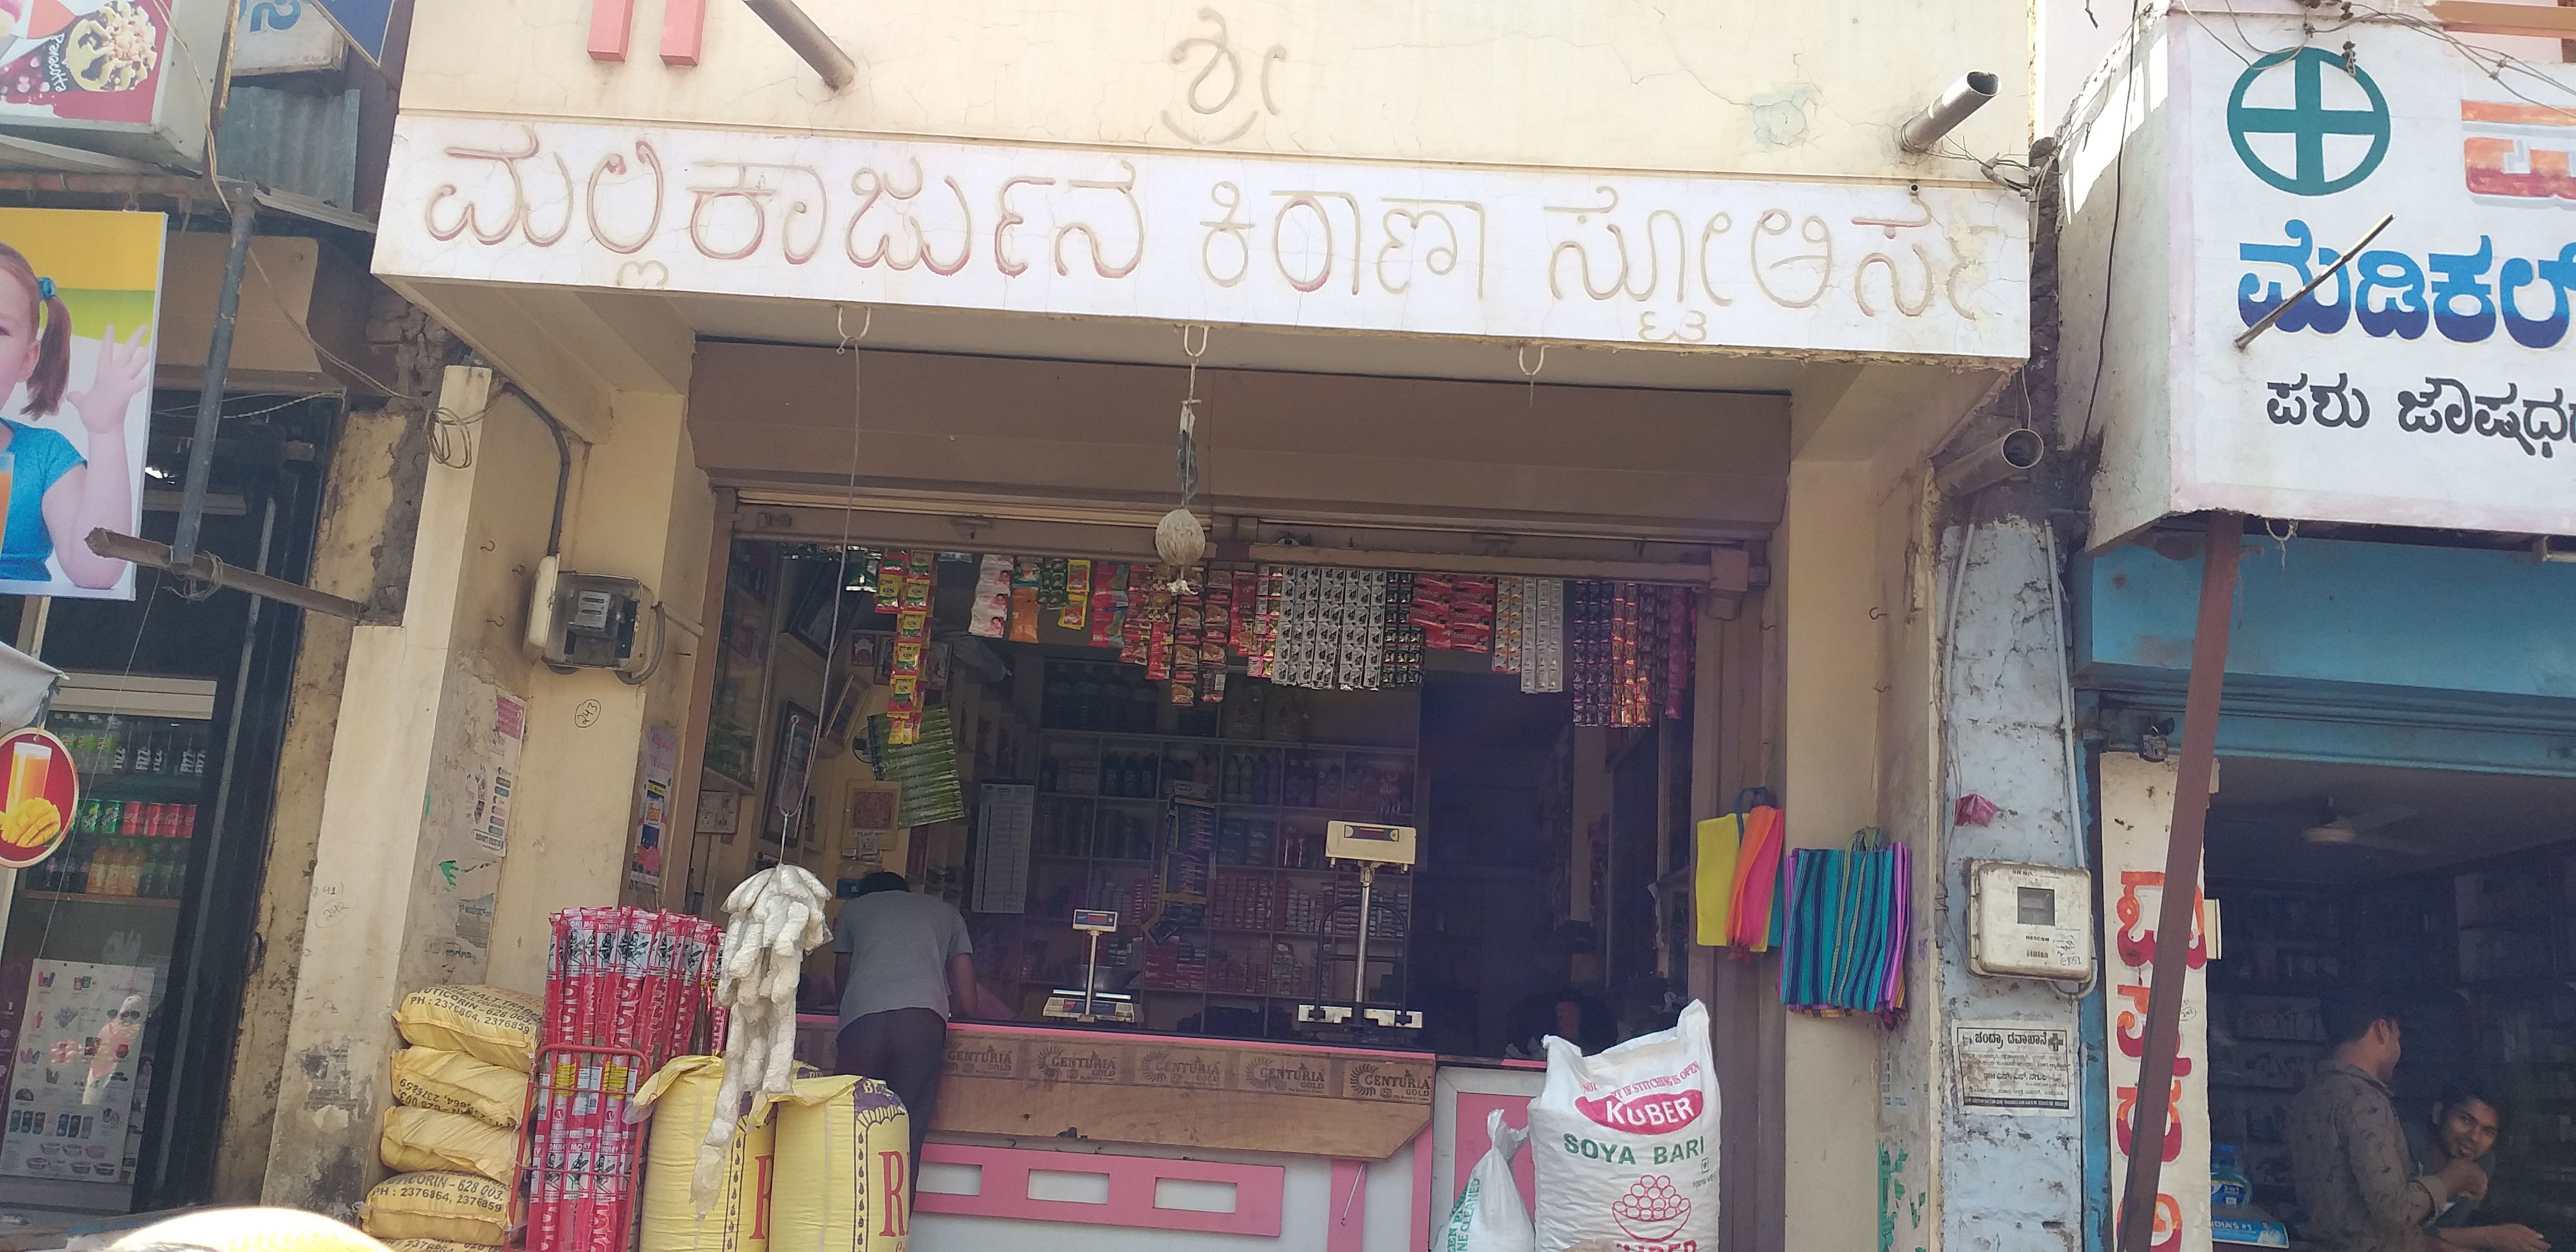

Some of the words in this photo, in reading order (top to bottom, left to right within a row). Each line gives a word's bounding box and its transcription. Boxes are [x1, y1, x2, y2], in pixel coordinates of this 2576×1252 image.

[2267, 373, 2371, 429] ಪಶು
[577, 702, 598, 724] 243
[469, 990, 501, 1003] SALT
[411, 996, 426, 1005] PH
[484, 1017, 530, 1034] 2376859
[486, 1008, 506, 1018] 628
[1259, 1067, 1325, 1082] CENTURIA
[1680, 1061, 1700, 1080] OPEN
[1364, 1074, 1431, 1089] CENTURIA
[1405, 1088, 1430, 1097] GOLD
[1606, 1098, 1695, 1126] KUBER
[1563, 1133, 1636, 1165] SOYA
[1652, 1135, 1704, 1165] BARI
[457, 1179, 478, 1193] 628
[372, 1187, 389, 1196] PH
[456, 1195, 502, 1212] 2376859
